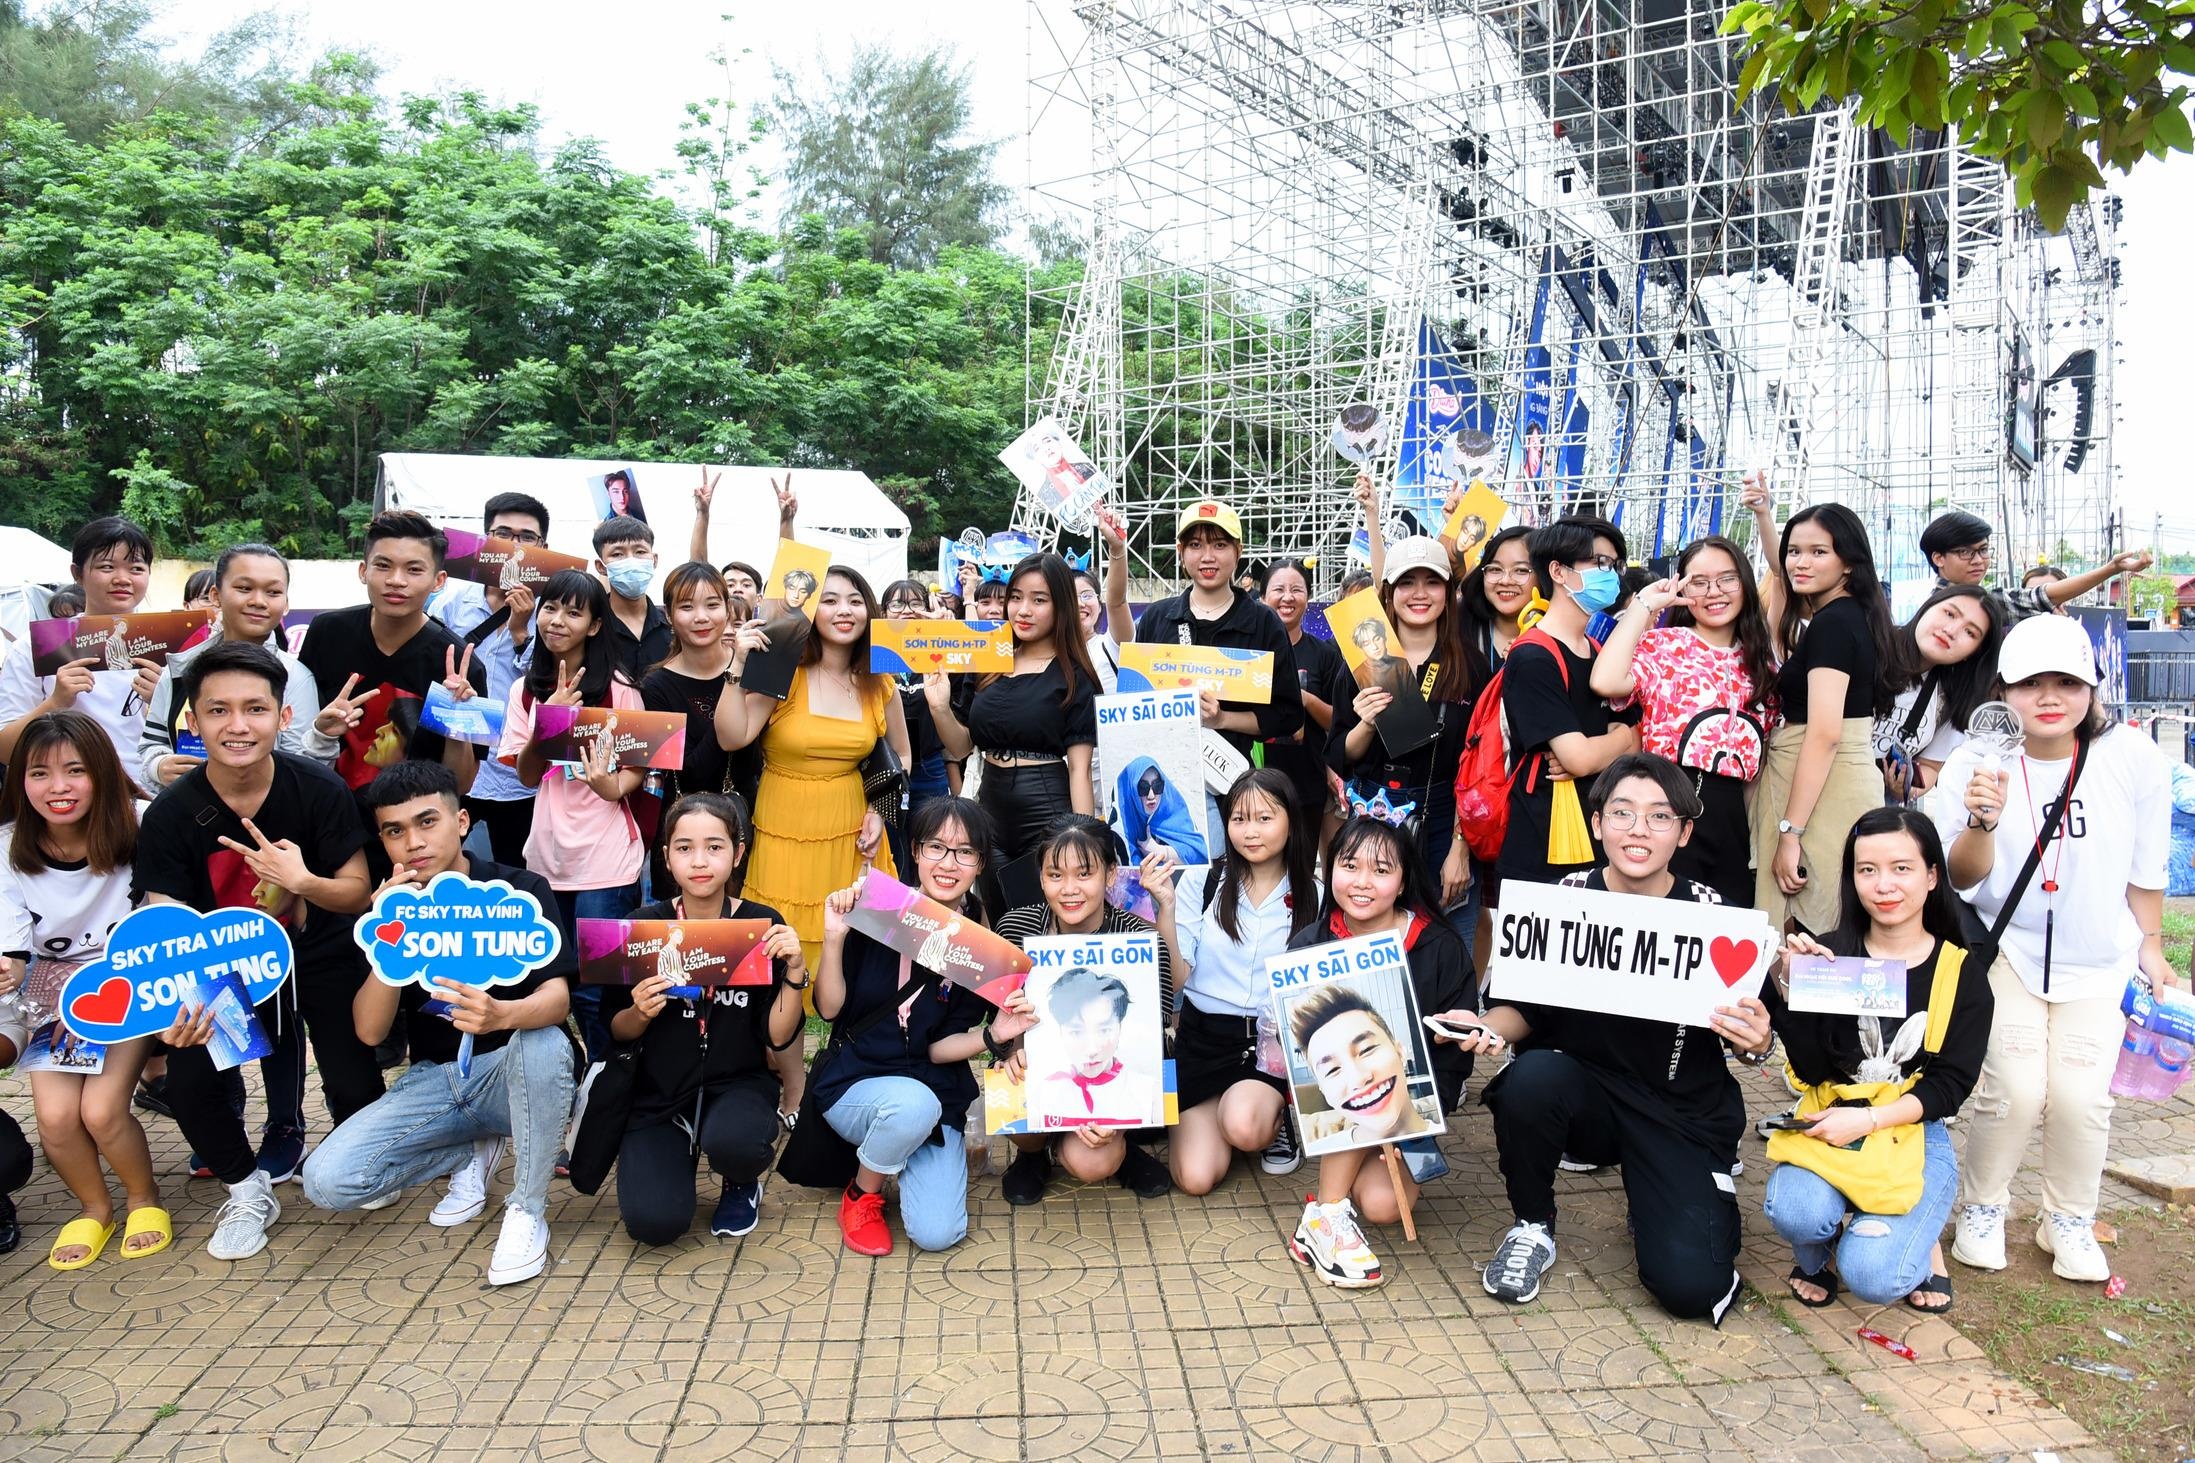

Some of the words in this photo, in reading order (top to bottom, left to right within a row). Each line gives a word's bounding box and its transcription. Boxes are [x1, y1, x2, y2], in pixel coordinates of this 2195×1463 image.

[76, 633, 93, 643] YOU
[94, 630, 109, 639] ARE
[76, 640, 88, 649] MY
[89, 636, 107, 647] EARL
[133, 636, 146, 645] AM
[905, 639, 928, 648] SƠN
[930, 637, 960, 648] TÙNG
[962, 640, 986, 648] M-TP
[128, 640, 152, 651] YOUR
[129, 643, 167, 657] COUNTESS
[946, 653, 972, 664] SKY
[1153, 662, 1176, 672] SƠN
[1215, 667, 1242, 677] M-TP
[1424, 666, 1437, 688] LOVE
[1196, 679, 1224, 692] SKY
[1100, 706, 1127, 724] SKY
[574, 724, 588, 732] YOU
[615, 742, 648, 752] COUNTESS
[616, 738, 636, 748] YOUR
[1202, 745, 1230, 772] LUCK
[396, 905, 416, 919] FC
[418, 905, 450, 919] SKY
[452, 905, 483, 919] TRA
[901, 918, 914, 926] MY
[915, 922, 935, 932] EARL
[906, 912, 922, 922] YOU
[924, 918, 940, 928] ARE
[112, 943, 158, 971] SKY
[161, 933, 208, 958] TRA
[210, 918, 265, 947] VINH
[402, 930, 462, 958] SON
[472, 930, 546, 957] TUNG
[627, 941, 645, 950] YOU
[646, 938, 662, 947] ARE
[1500, 912, 1550, 962] SƠN
[1560, 911, 1623, 971] TÙNG
[1630, 930, 1704, 980] M-TP
[628, 949, 641, 958] MY
[642, 946, 662, 956] EARL
[683, 951, 687, 959] I
[688, 947, 703, 957] AM
[684, 953, 709, 964] YOUR
[948, 949, 973, 961] YOUR
[1027, 949, 1066, 967] SKY
[684, 957, 726, 972] COUNTESS
[944, 954, 984, 972] COUNTESS
[1271, 964, 1310, 989] SKY
[137, 971, 198, 1012] SON
[1669, 1040, 1684, 1080] SYSTEM
